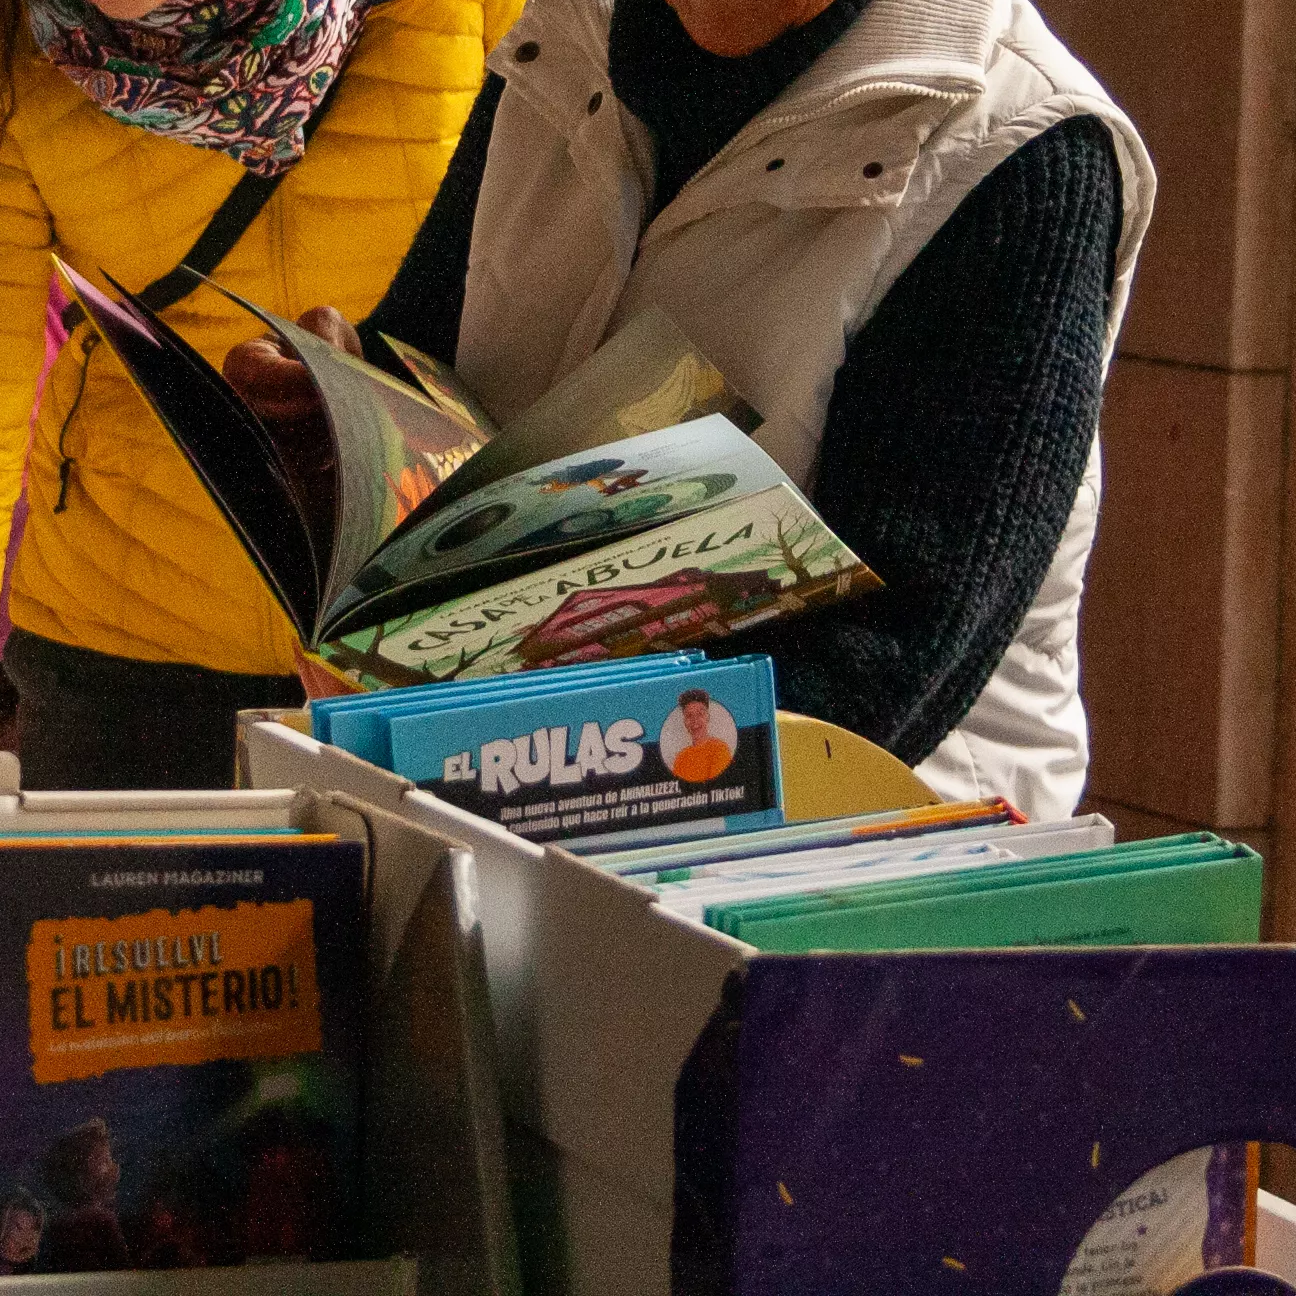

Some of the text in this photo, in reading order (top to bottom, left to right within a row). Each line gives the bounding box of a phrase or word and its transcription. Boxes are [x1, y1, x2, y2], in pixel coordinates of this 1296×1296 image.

[407, 606, 517, 651] CASA
[556, 521, 755, 597] ABUELA
[443, 718, 645, 795] EL RULAS
[524, 801, 556, 817] nueva
[557, 793, 604, 813] aventura
[605, 790, 619, 803] de
[561, 810, 582, 828] que
[582, 806, 609, 824] hace
[630, 803, 639, 816] a
[639, 801, 650, 814] la
[651, 792, 709, 814] generación
[710, 785, 745, 802] TikTok!
[90, 869, 265, 887] LAUREN MAGAZINER
[52, 931, 224, 983] ¡RESUELVE
[51, 963, 300, 1031] EL MISTERIO!
